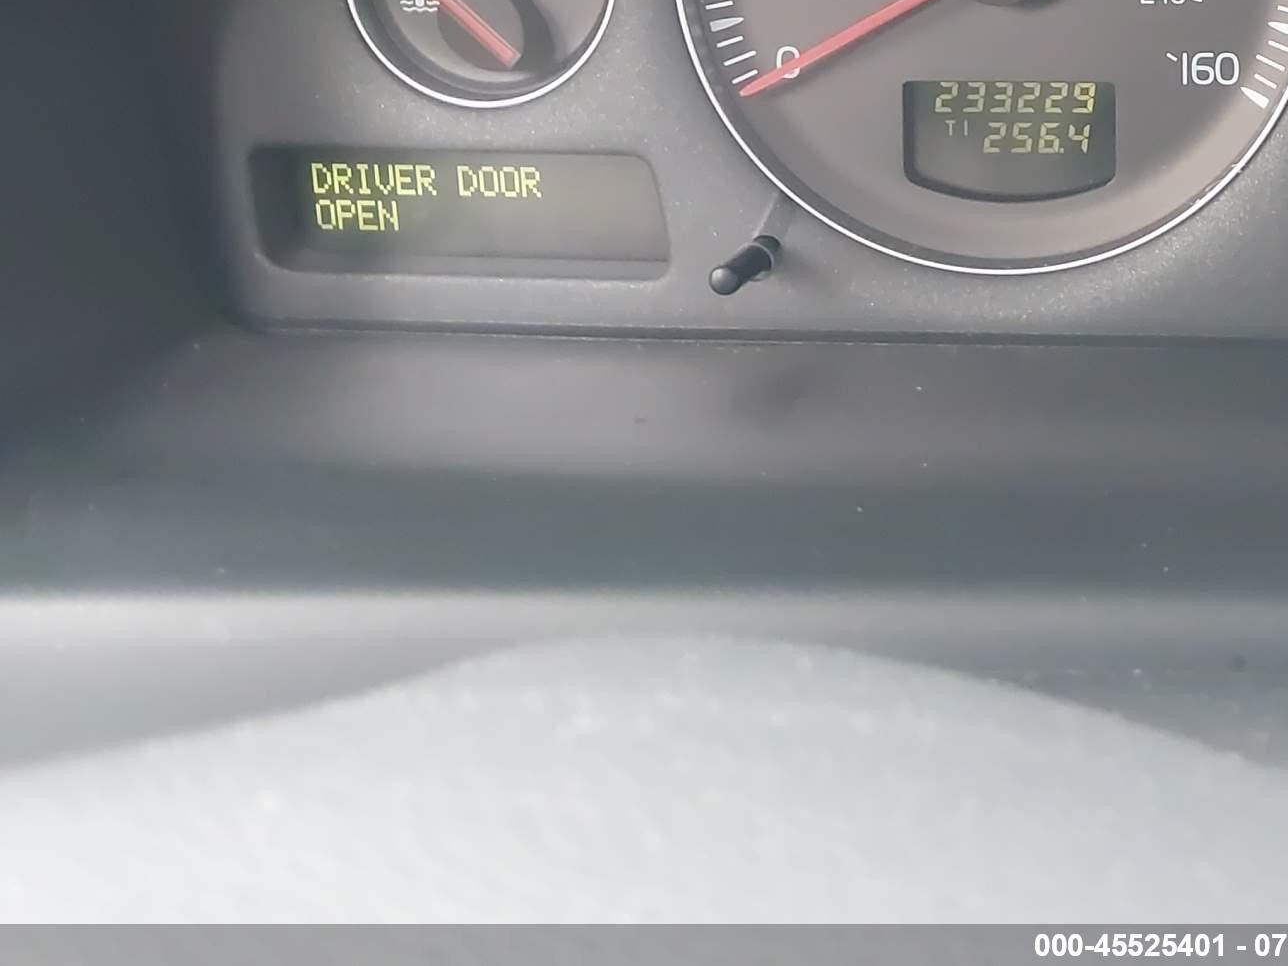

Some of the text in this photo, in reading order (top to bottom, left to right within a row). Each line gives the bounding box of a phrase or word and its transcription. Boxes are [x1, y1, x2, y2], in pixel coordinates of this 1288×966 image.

[776, 47, 801, 79] 0
[1181, 51, 1239, 85] 160
[934, 82, 1096, 114] 233229
[983, 123, 1090, 154] 256.4
[311, 162, 542, 198] DRIVER DOOR
[315, 199, 399, 231] OPEN
